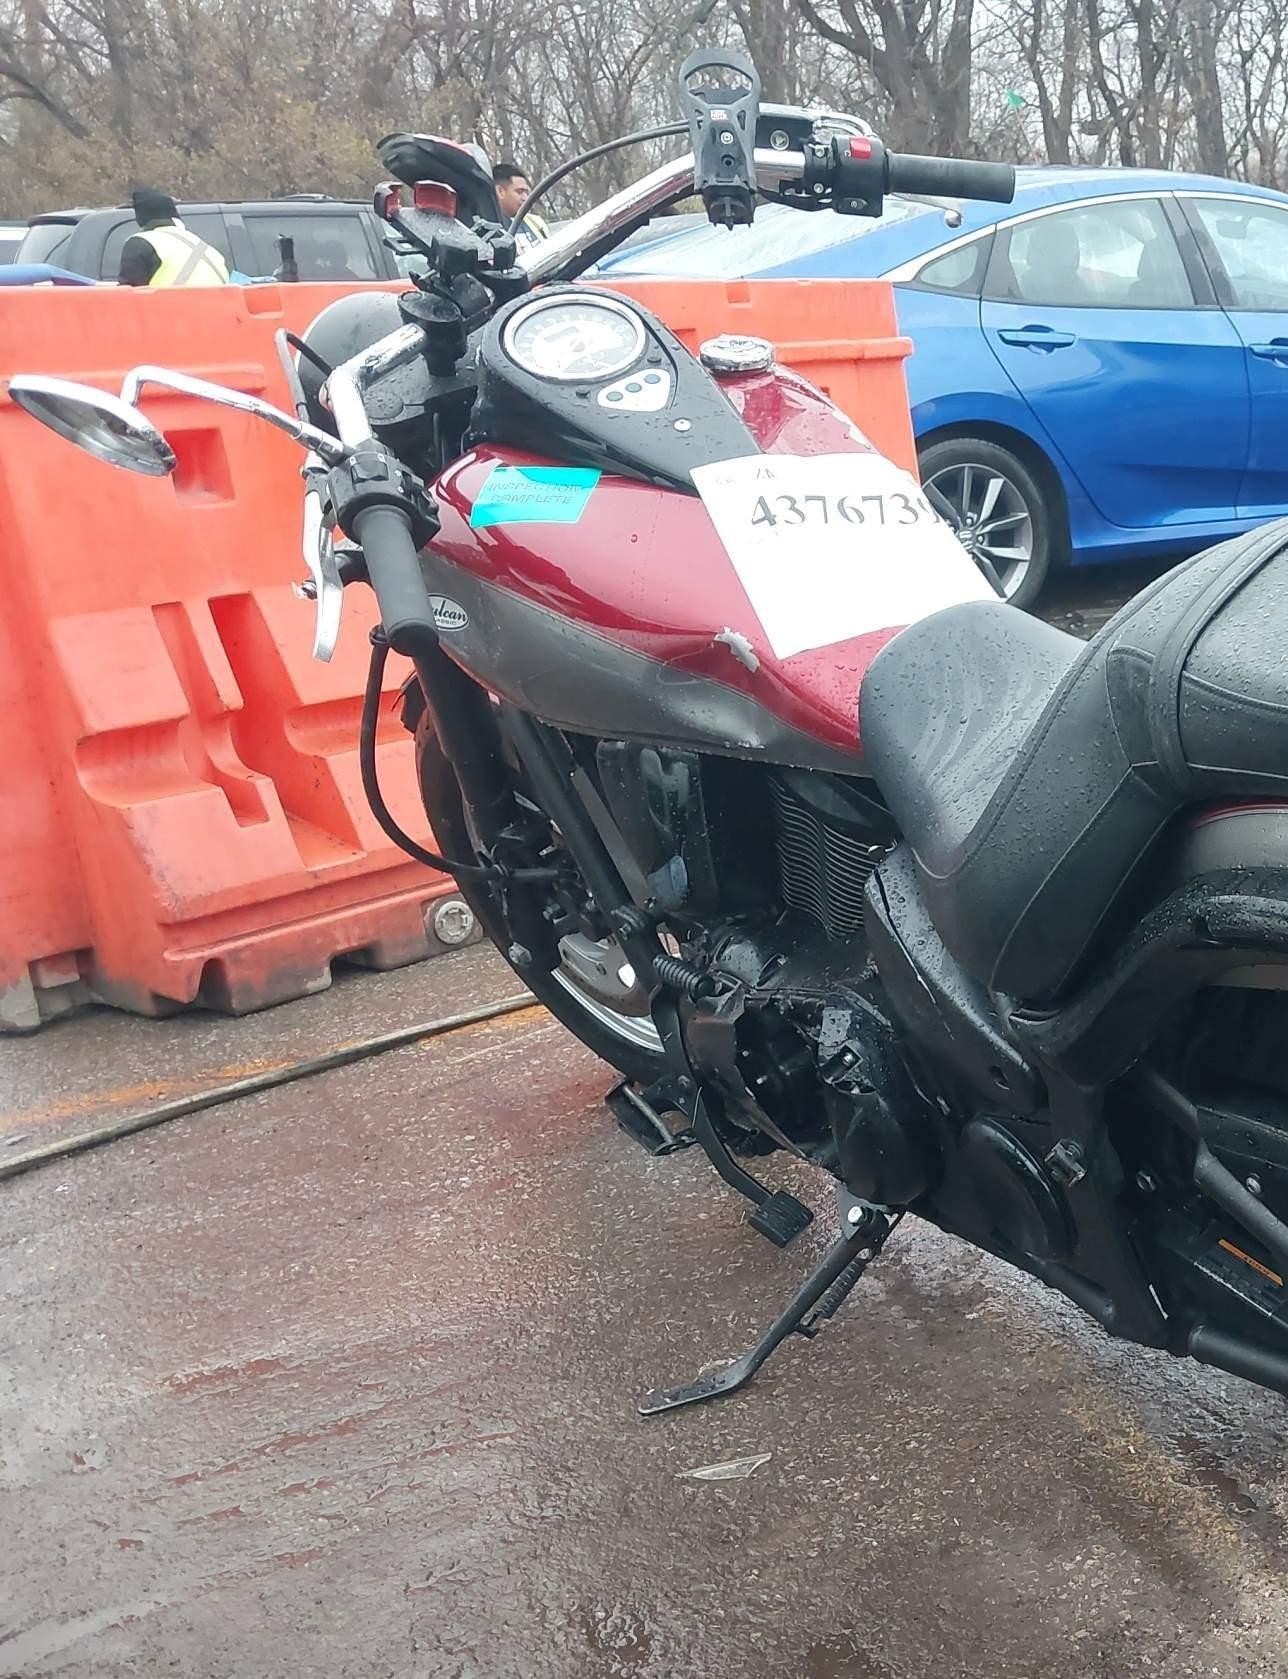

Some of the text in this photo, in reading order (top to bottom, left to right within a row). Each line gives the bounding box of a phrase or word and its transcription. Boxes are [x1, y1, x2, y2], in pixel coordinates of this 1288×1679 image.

[488, 482, 580, 494] INSPECTION
[490, 494, 574, 504] COMPLETE
[432, 600, 466, 621] ulcan
